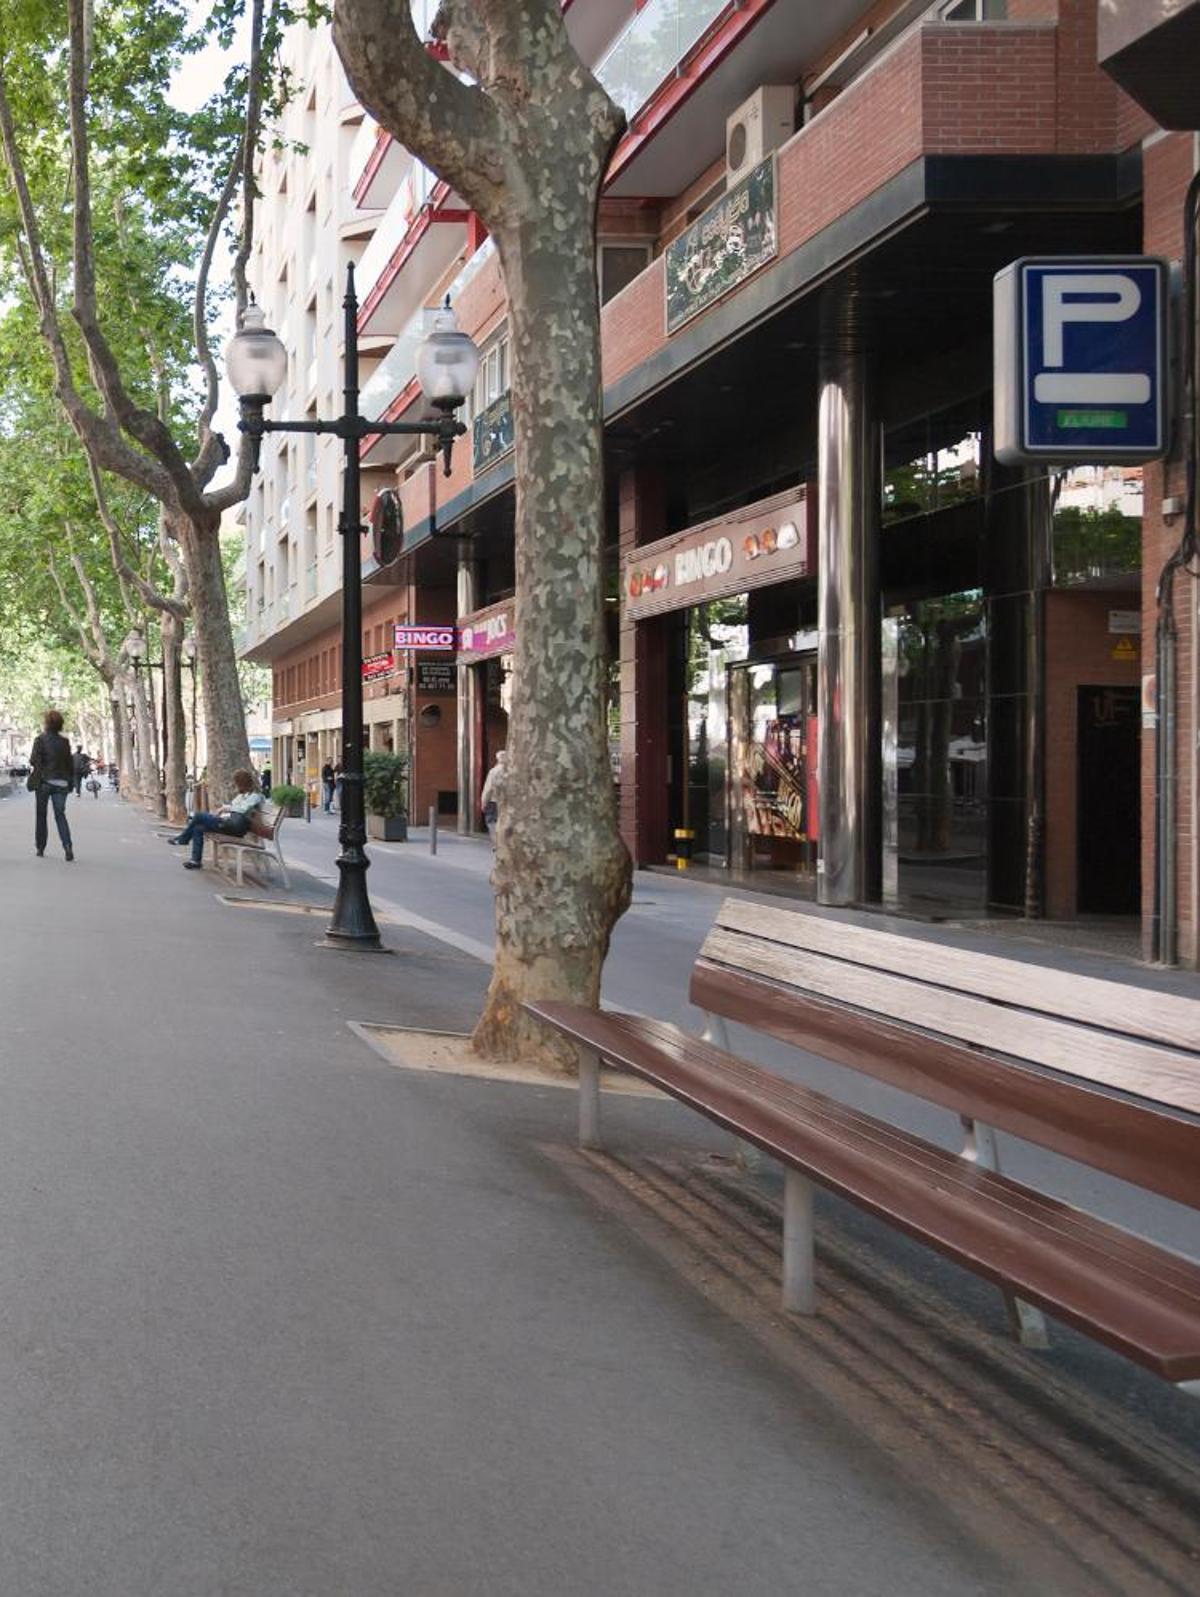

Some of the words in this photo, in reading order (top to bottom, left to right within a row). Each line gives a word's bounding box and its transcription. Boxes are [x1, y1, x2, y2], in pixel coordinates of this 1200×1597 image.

[1041, 274, 1141, 367] P
[674, 536, 732, 586] BINGO
[395, 631, 453, 645] BINGO
